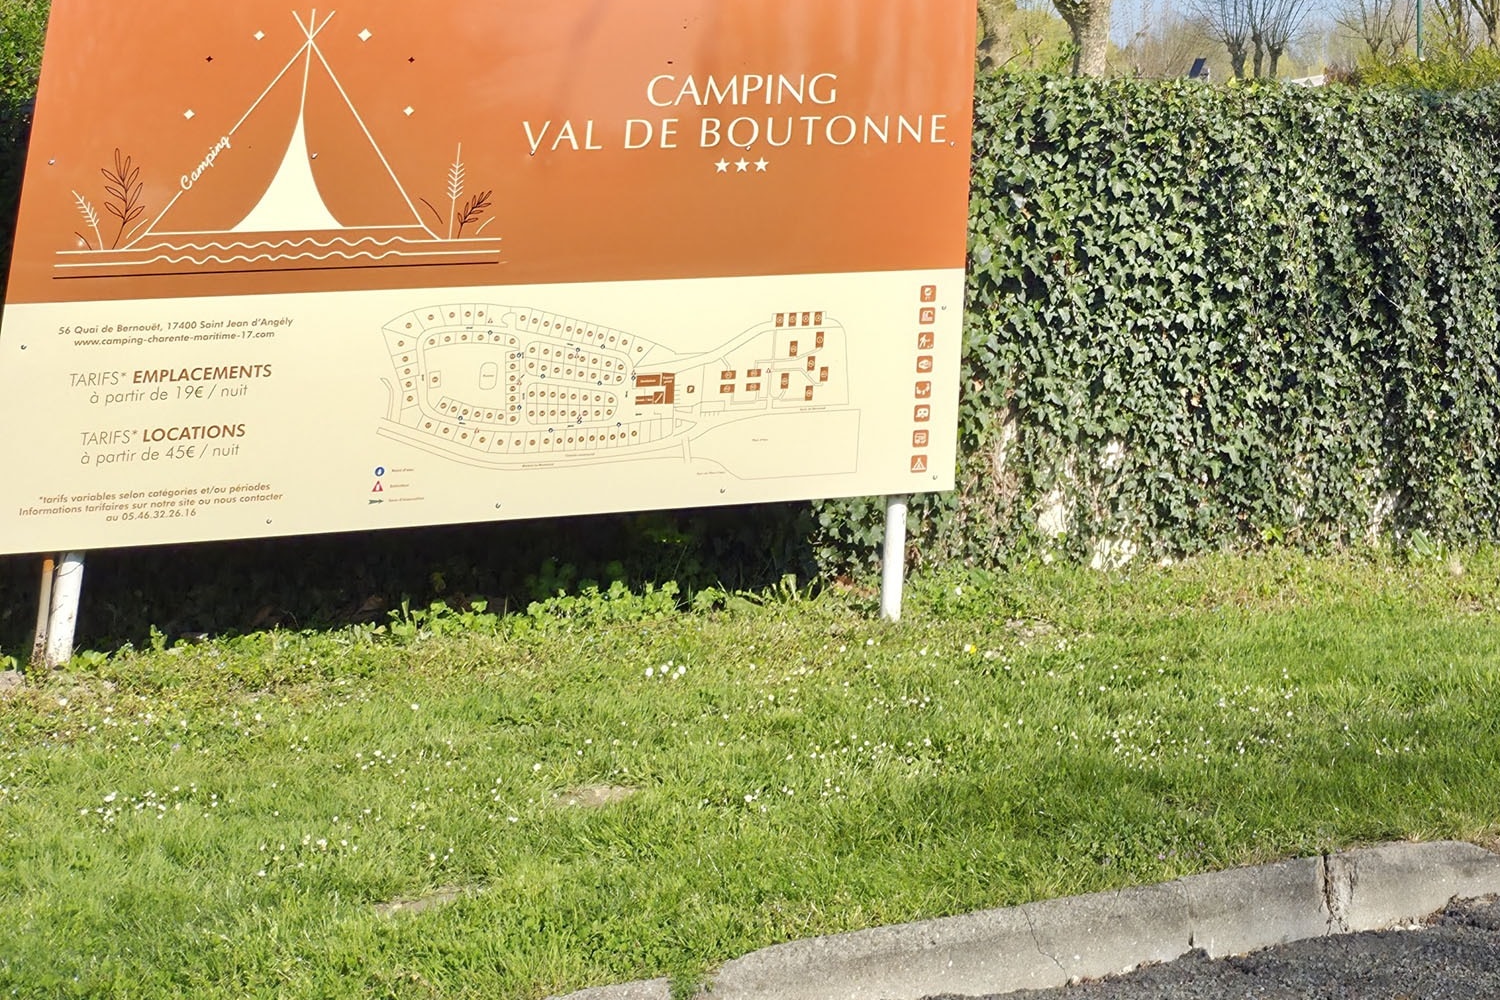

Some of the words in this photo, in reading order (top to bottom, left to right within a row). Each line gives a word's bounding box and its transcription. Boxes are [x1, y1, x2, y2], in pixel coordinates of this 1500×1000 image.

[646, 73, 837, 107] CAMPING
[523, 119, 602, 152] VAL
[624, 118, 679, 150] DE
[700, 114, 948, 148] BOUTONNE
[180, 136, 231, 190] Camping
[58, 326, 71, 335] 56
[74, 325, 99, 335] Quai
[101, 324, 114, 334] de
[116, 321, 163, 333] Bernouët,
[167, 320, 197, 330] 17400
[200, 319, 224, 329] Saint
[226, 319, 249, 328] Jean
[74, 330, 275, 347] www.camping-charente-maritime-17.com
[133, 364, 272, 384] EMPLACEMENTS
[90, 391, 99, 404] à
[104, 389, 146, 406] partir
[149, 386, 168, 401] de
[176, 385, 204, 400] 19€
[220, 384, 248, 398] nuit
[143, 423, 246, 443] LOCATIONS
[80, 452, 90, 464] à
[96, 449, 136, 467] partir
[141, 447, 160, 461] de
[165, 445, 196, 460] 45€
[212, 444, 240, 457] nuit
[71, 491, 116, 502] variables
[119, 490, 146, 500] selon
[148, 486, 198, 499] catégories
[200, 485, 227, 496] et/ou
[229, 482, 271, 495] périodes
[19, 504, 82, 516] Informations
[85, 501, 130, 512] tarifaires
[132, 502, 148, 510] sur
[150, 499, 176, 508] notre
[178, 497, 196, 507] site
[198, 498, 211, 506] ou
[213, 496, 237, 504] nous
[239, 492, 284, 503] contacter
[106, 514, 119, 522] au
[121, 508, 197, 521] 05.46.32.26.16
